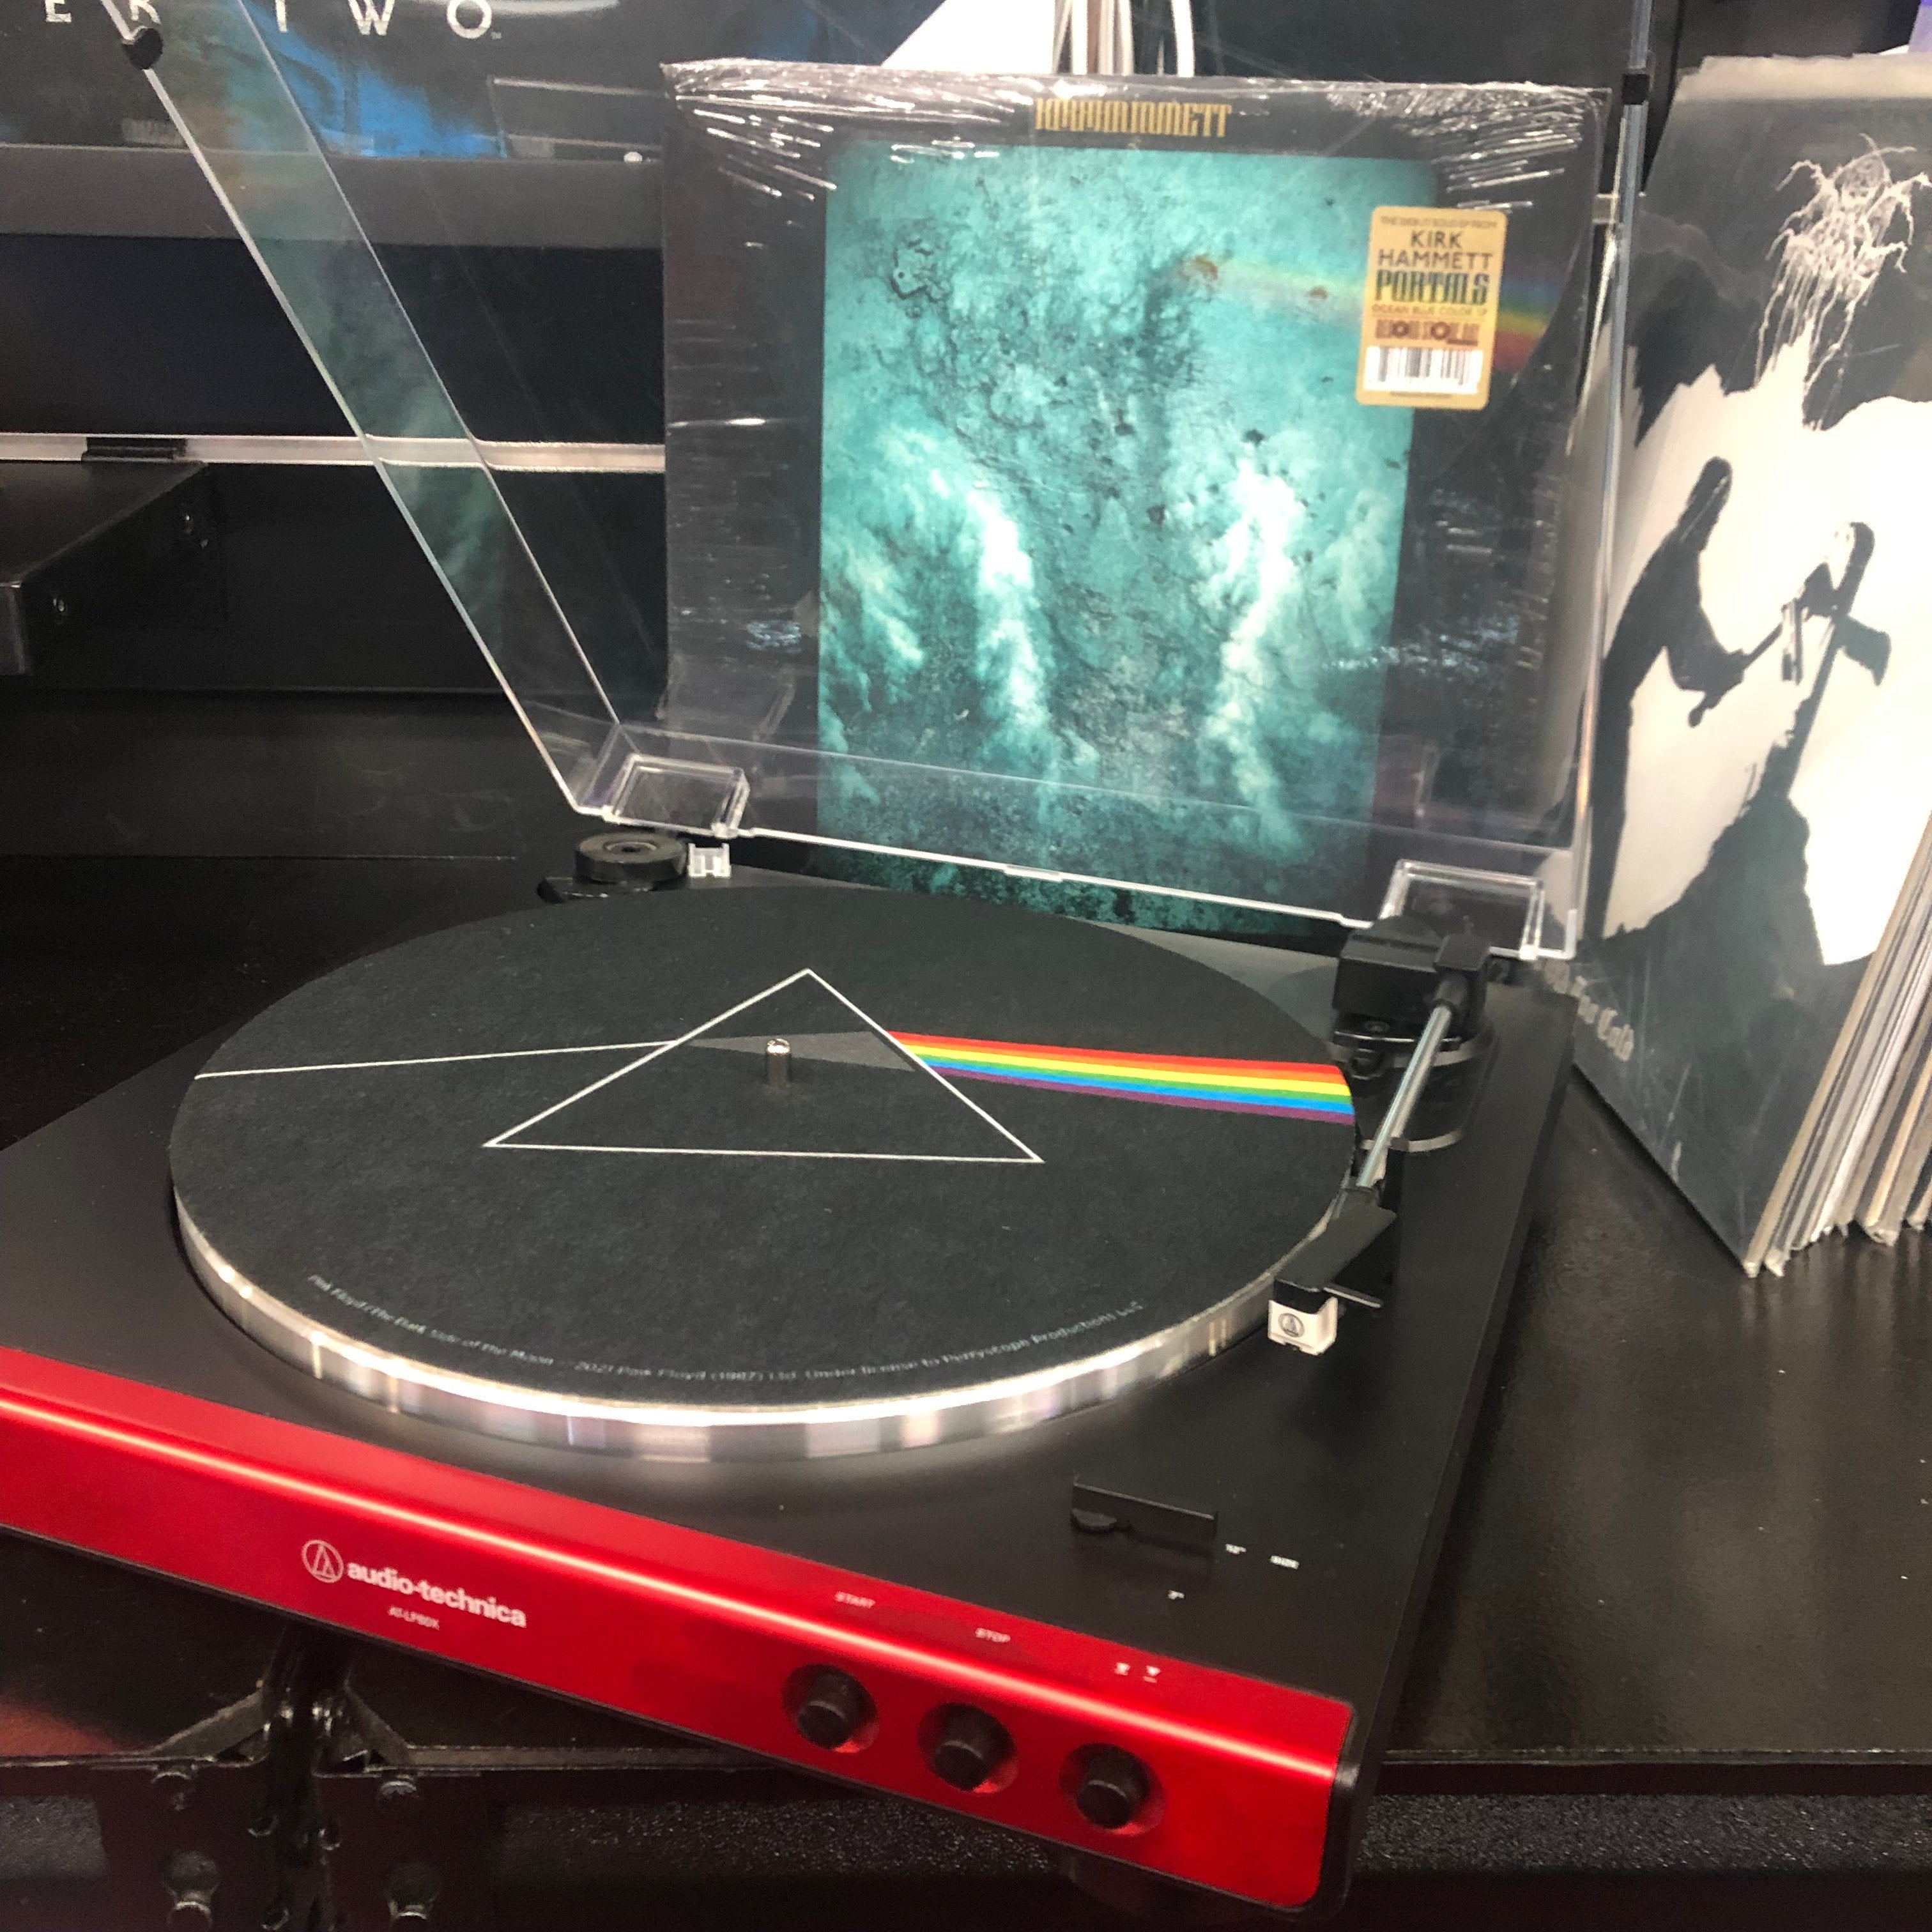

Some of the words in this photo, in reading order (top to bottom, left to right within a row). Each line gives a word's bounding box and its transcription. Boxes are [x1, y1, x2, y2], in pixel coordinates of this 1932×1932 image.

[1411, 229, 1462, 250] KIRK
[1378, 247, 1494, 271] HAMMETT
[347, 1562, 528, 1629] audio-technica
[975, 1627, 1011, 1643] STOP
